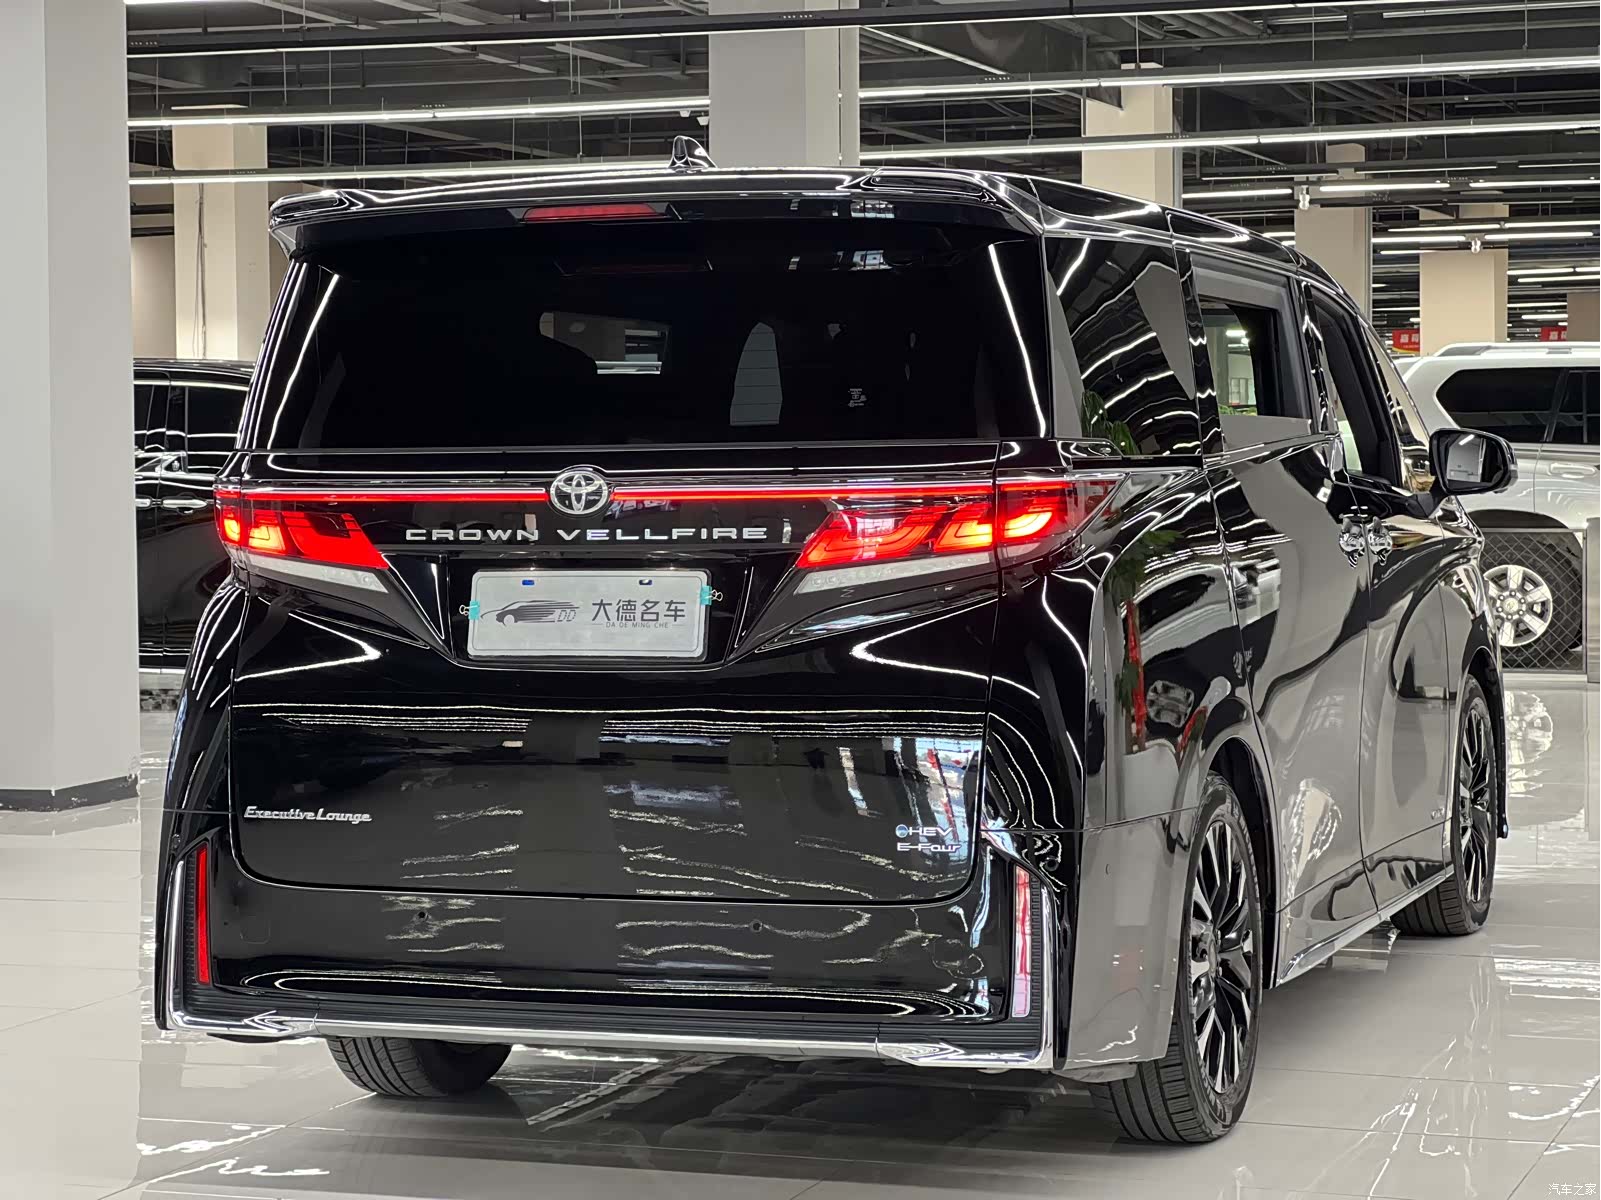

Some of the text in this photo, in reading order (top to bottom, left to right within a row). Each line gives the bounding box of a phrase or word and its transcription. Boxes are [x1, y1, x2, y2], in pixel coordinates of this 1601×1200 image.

[406, 527, 768, 541] CROWN VELLFIRE
[592, 598, 686, 622] 大德名车
[605, 621, 669, 629] DA DE MING CHE
